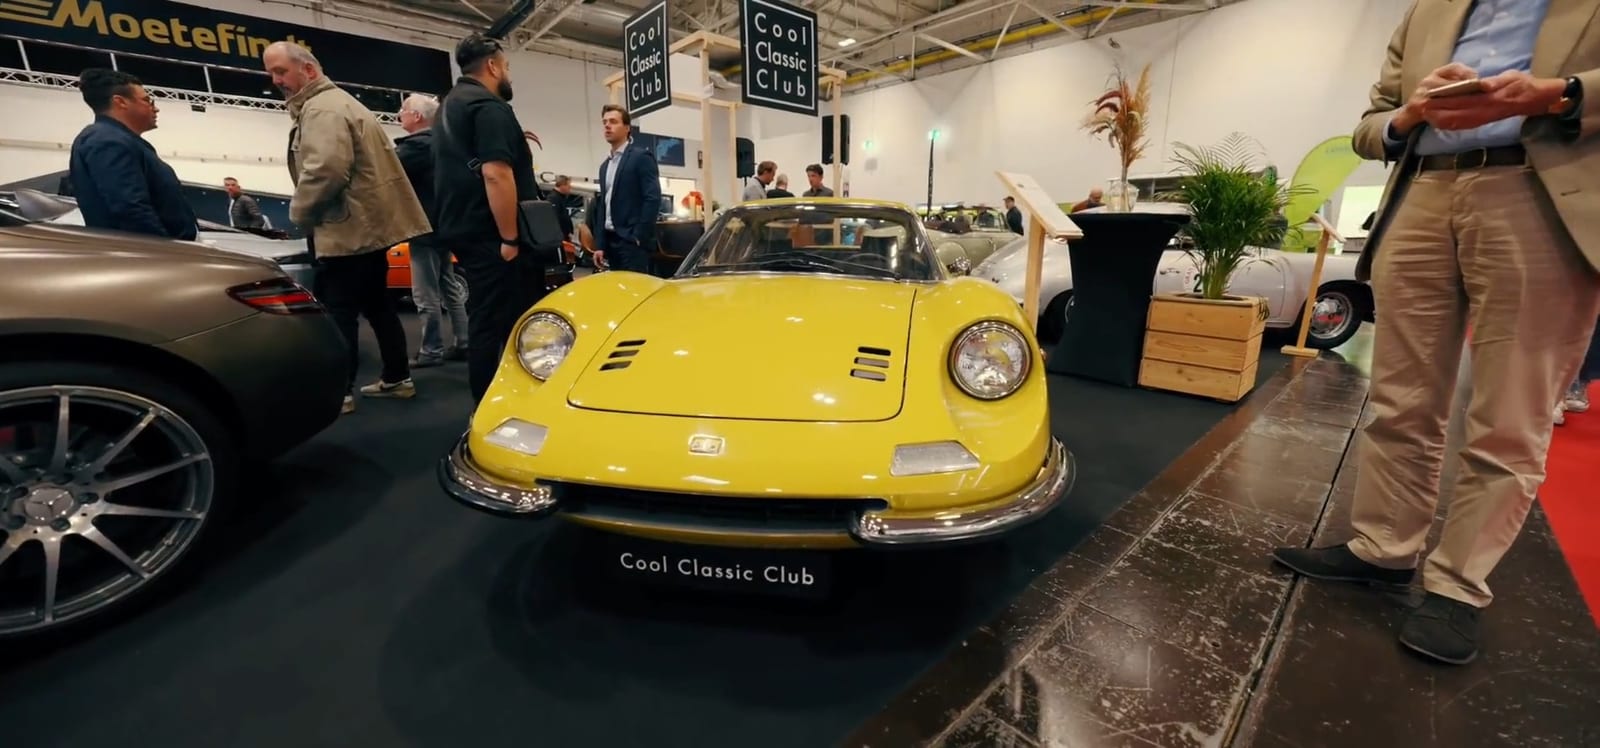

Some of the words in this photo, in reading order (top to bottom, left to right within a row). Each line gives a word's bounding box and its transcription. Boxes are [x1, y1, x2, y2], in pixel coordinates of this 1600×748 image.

[51, 0, 313, 58] Moetefin
[630, 16, 661, 50] Cool
[754, 12, 807, 46] Cool
[630, 48, 661, 76] Classic
[755, 41, 807, 72] Classic
[632, 72, 662, 101] Club
[757, 69, 806, 97] Club
[620, 552, 668, 572] Cool
[678, 558, 753, 580] Classic
[764, 566, 814, 586] Club
